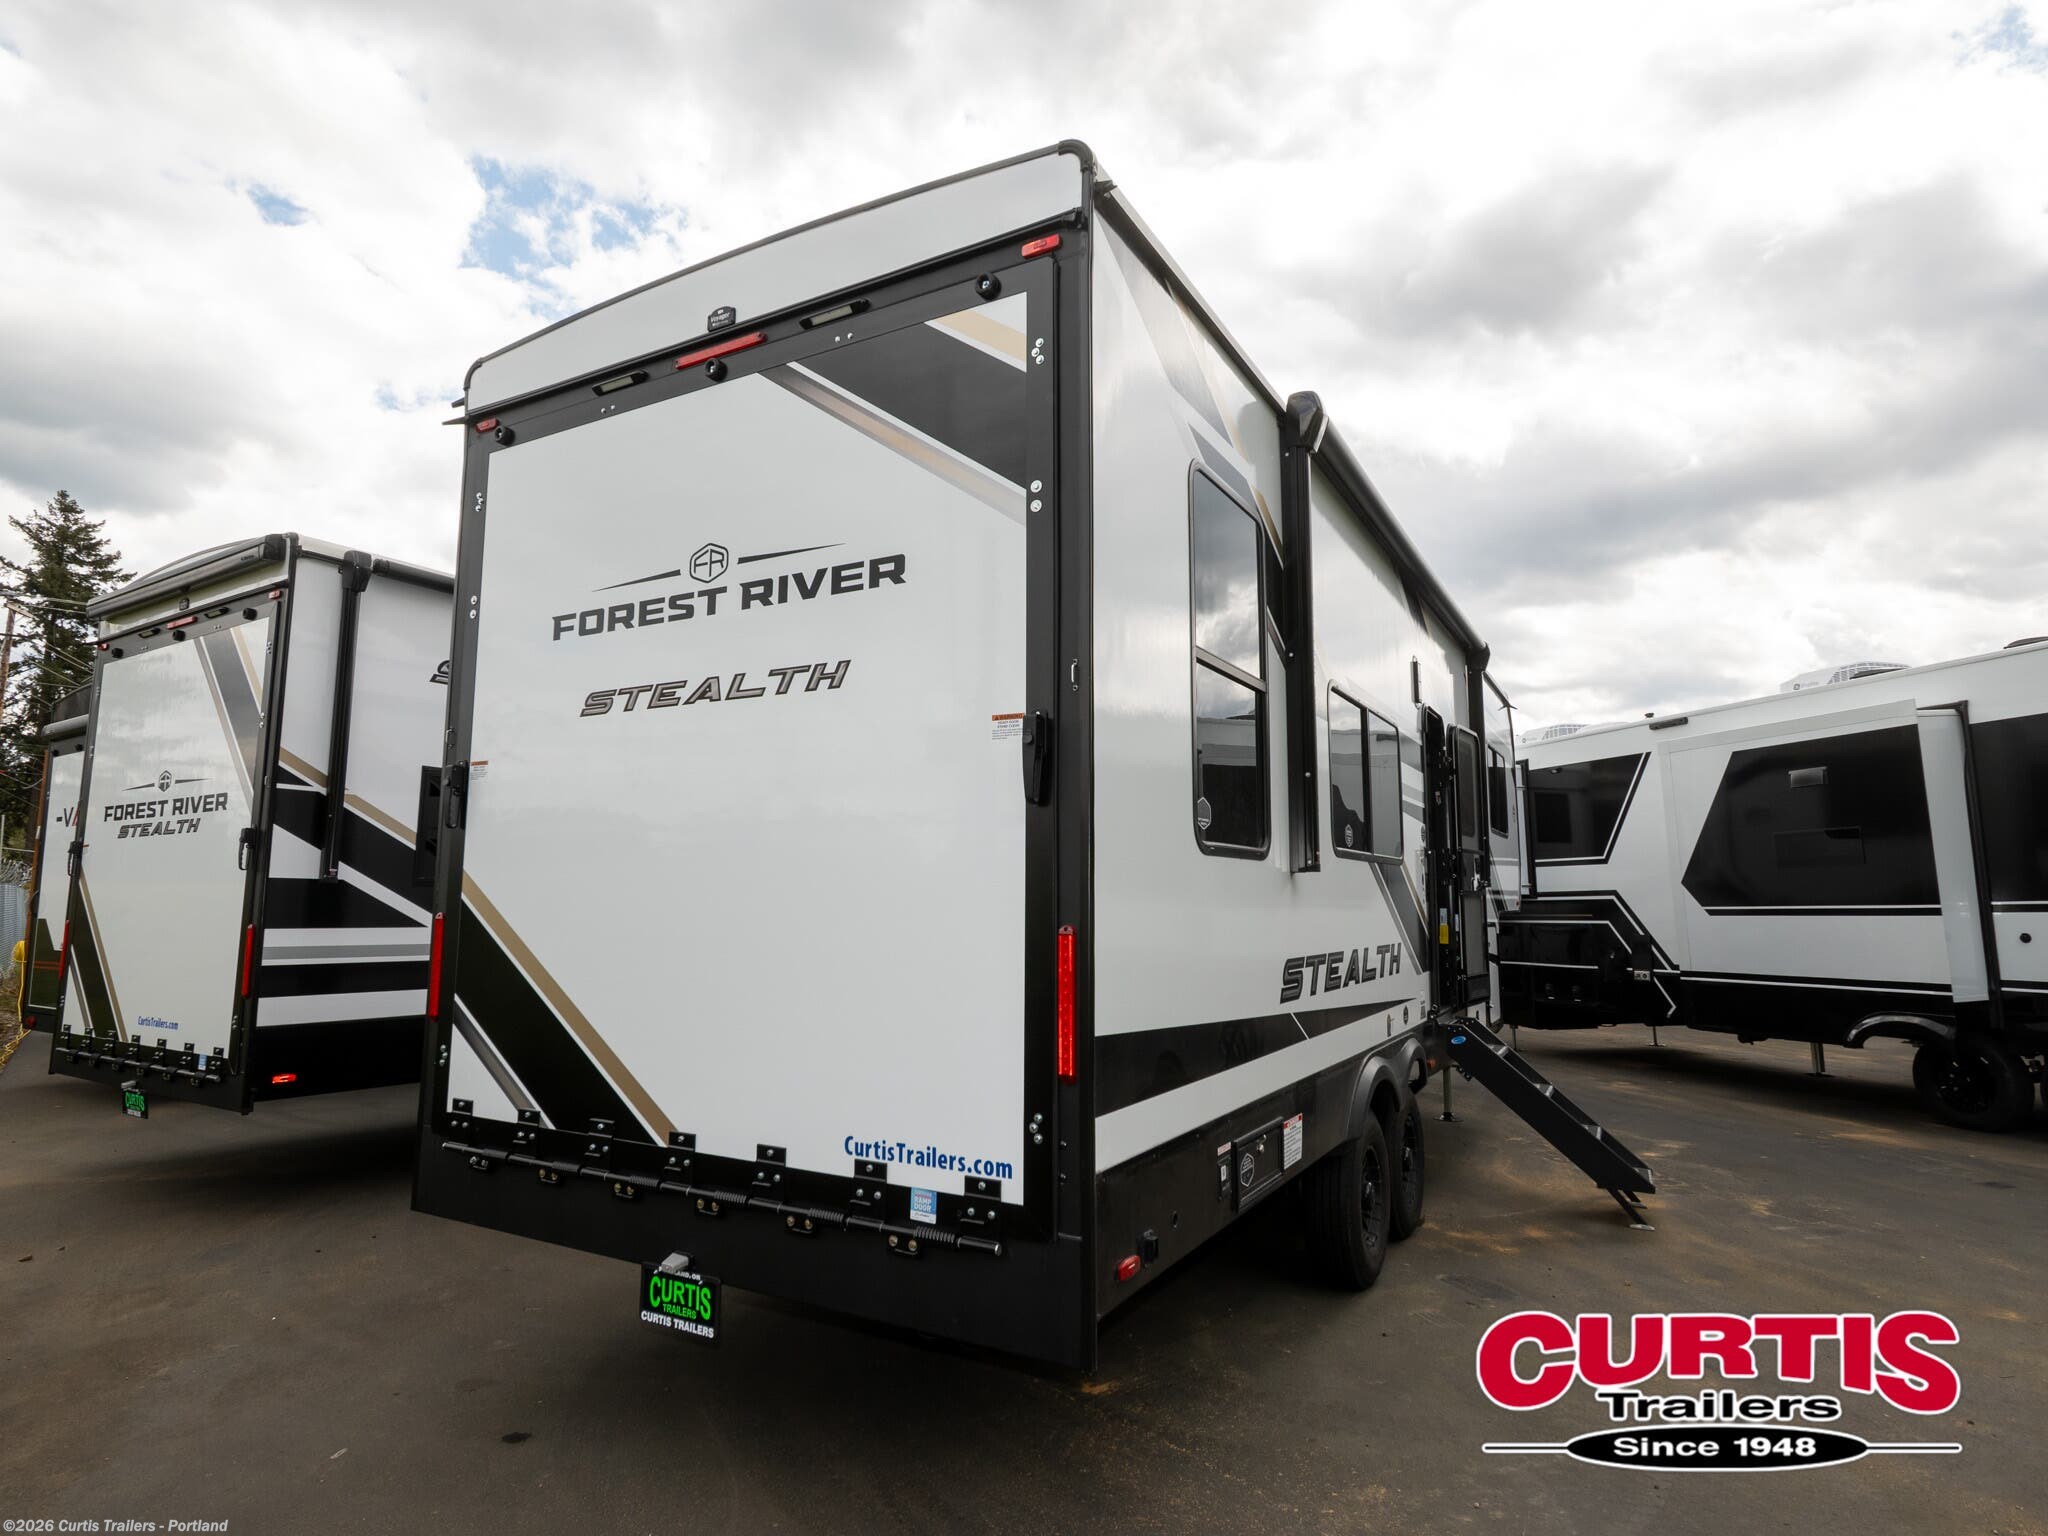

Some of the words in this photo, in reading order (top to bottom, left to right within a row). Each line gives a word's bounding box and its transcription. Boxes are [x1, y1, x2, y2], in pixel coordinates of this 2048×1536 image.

[552, 586, 727, 641] FOREST
[739, 553, 906, 610] RIVER
[580, 660, 851, 717] STEALTH
[104, 800, 168, 822] FOREST
[172, 792, 228, 816] RIVER
[117, 818, 201, 839] STEALTH
[1280, 942, 1402, 1004] STEALTH
[845, 1136, 1013, 1179] CurtisTrailers.com
[649, 1275, 711, 1320] CURTIS
[663, 1303, 697, 1319] TRAILERS
[641, 1310, 672, 1327] CURTIS
[673, 1318, 714, 1338] TRAILERS
